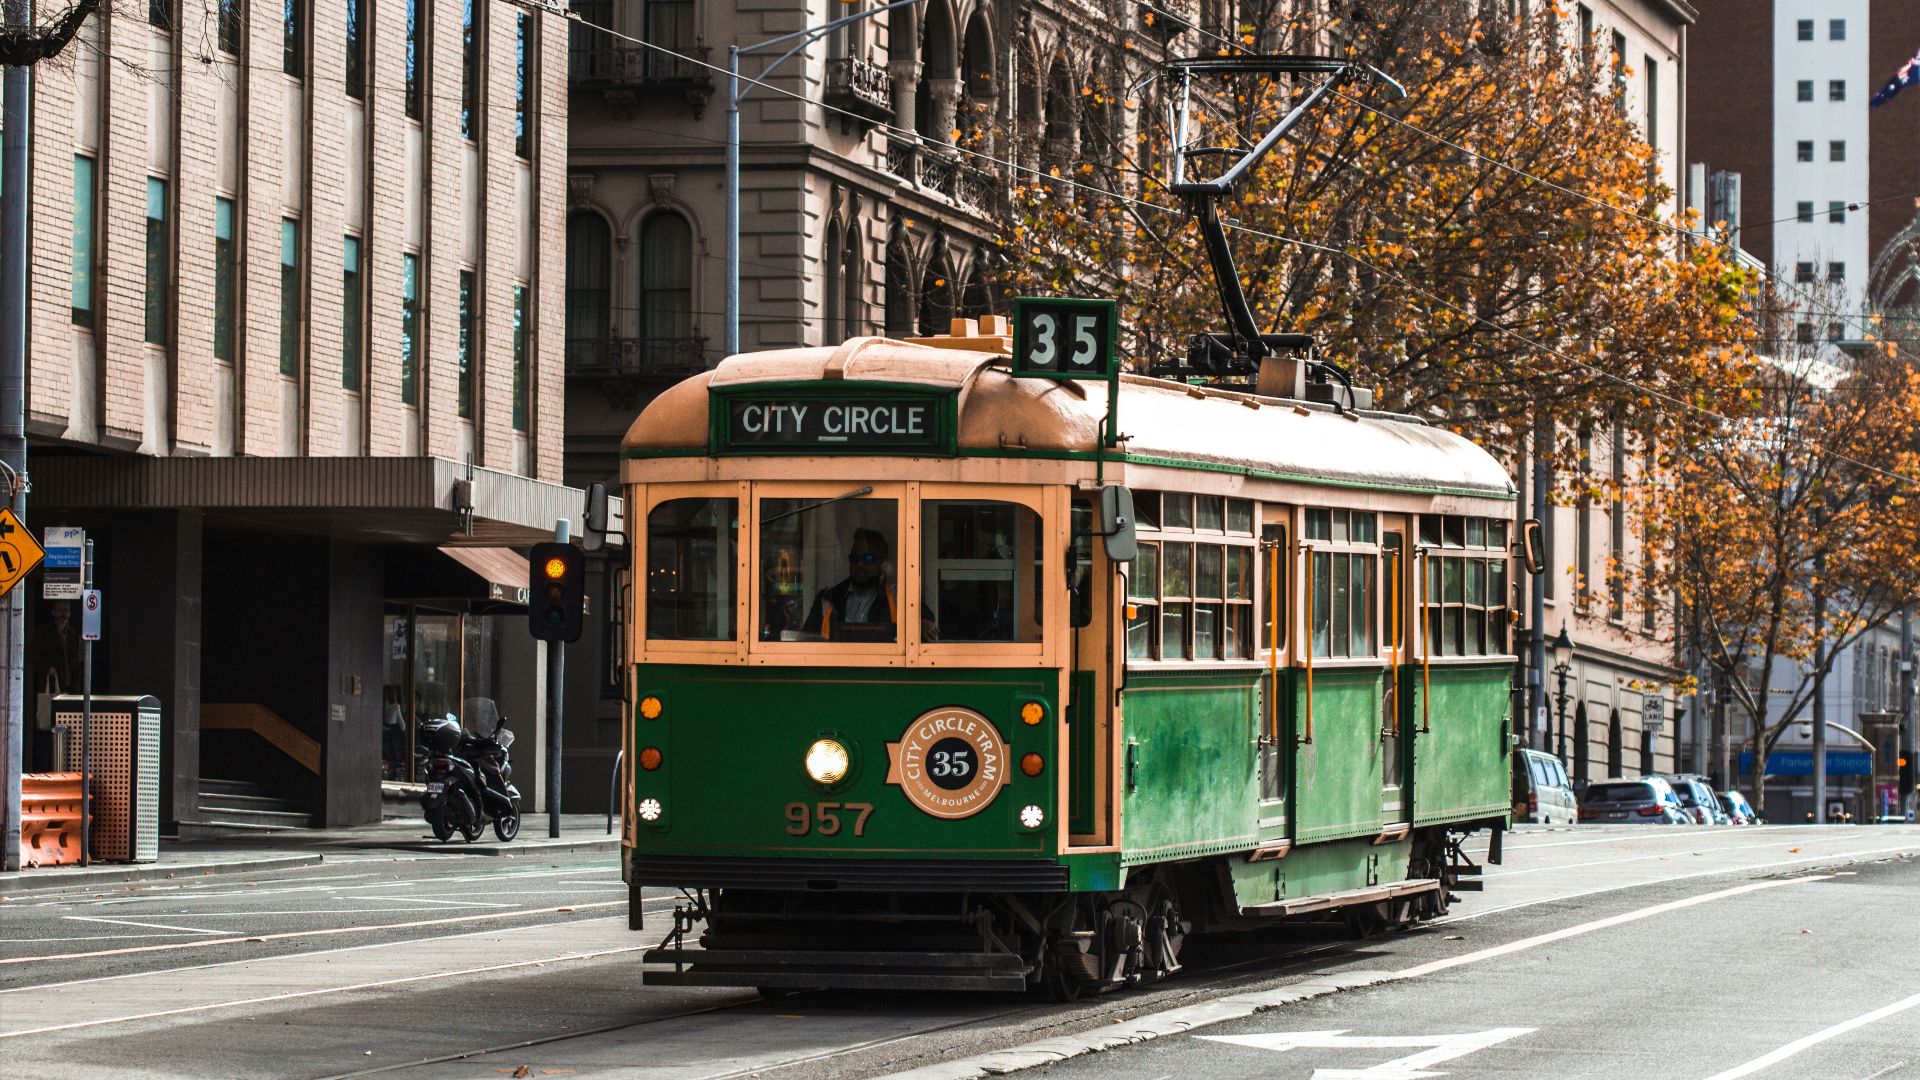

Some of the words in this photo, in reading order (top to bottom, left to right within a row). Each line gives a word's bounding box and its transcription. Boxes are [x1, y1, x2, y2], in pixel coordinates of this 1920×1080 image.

[1029, 313, 1097, 365] 35
[742, 405, 808, 433] CITY
[823, 406, 925, 434] CIRCLE
[906, 741, 922, 780] CITY
[920, 717, 977, 740] CIRCLE
[976, 731, 997, 780] TRAM
[932, 750, 970, 776] 35
[1837, 757, 1871, 768] Station
[923, 789, 981, 806] MELBOURNE
[784, 802, 874, 837] 957
